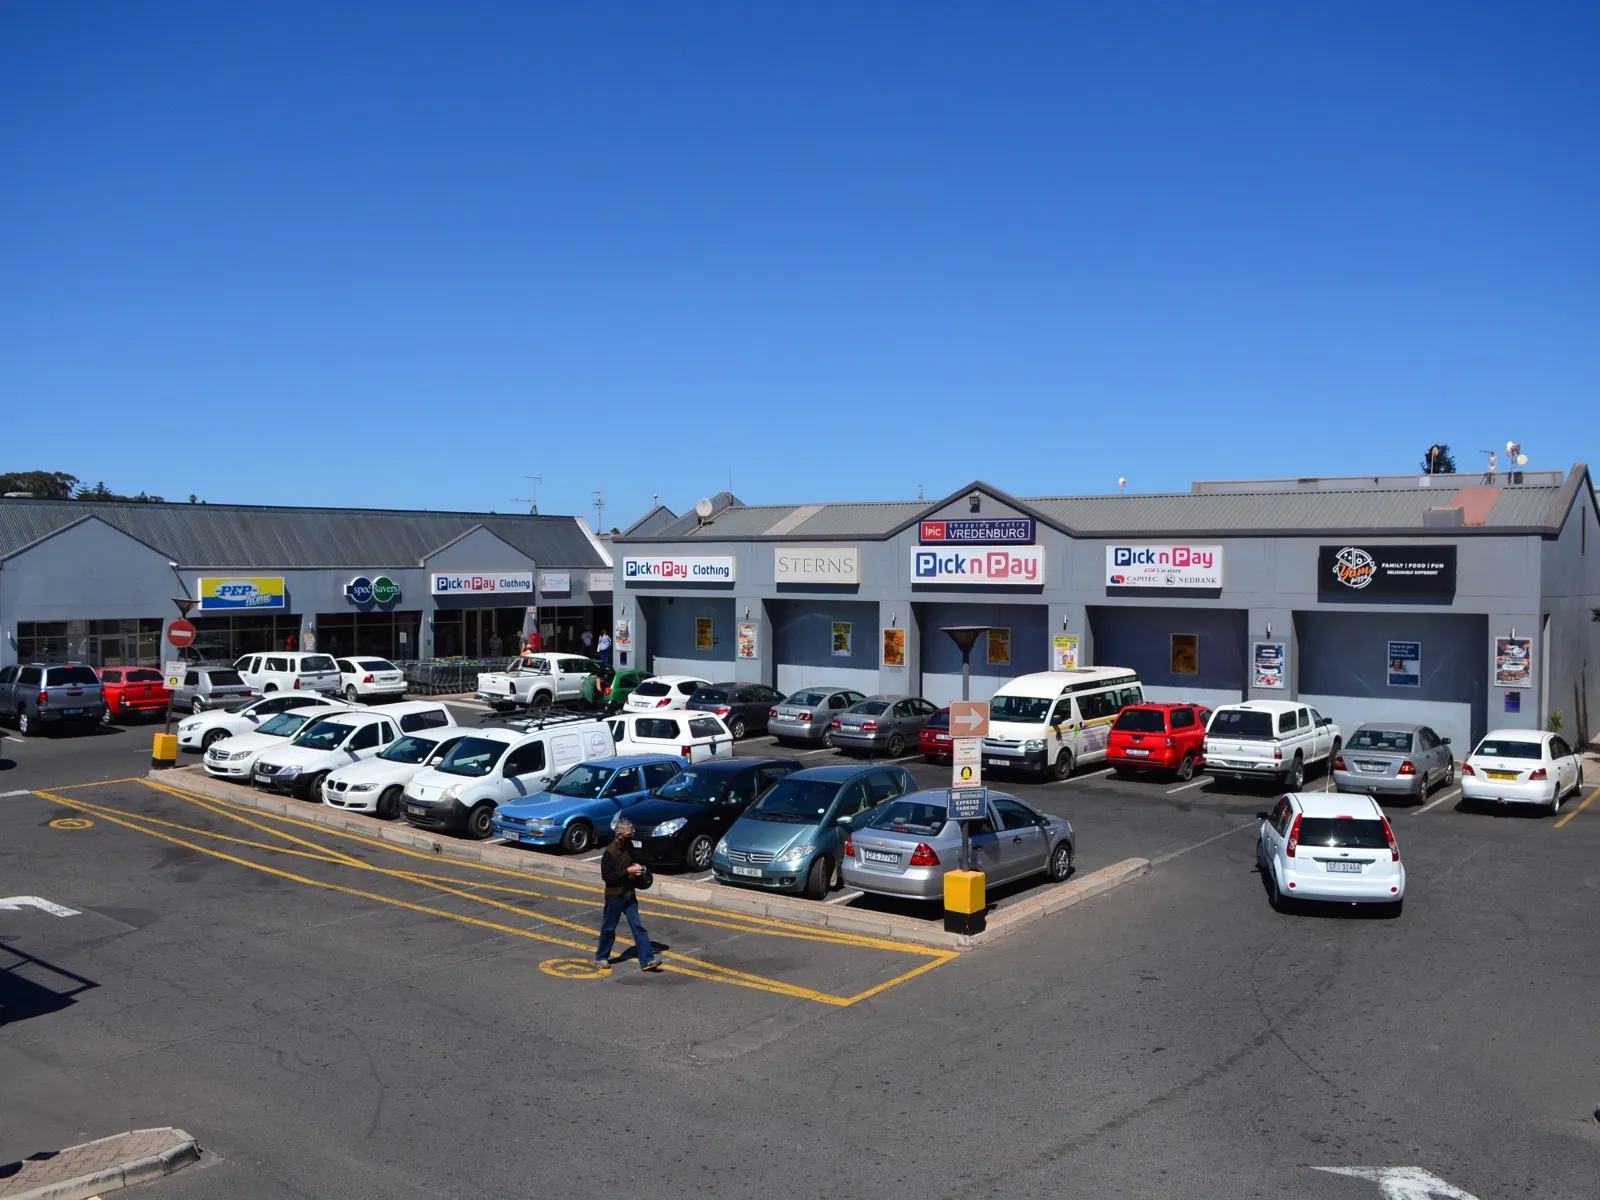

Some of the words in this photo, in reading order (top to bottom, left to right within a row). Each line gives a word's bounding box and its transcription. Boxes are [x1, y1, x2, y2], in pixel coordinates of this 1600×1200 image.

[950, 528, 1025, 538] VREDENBURG
[778, 556, 853, 573] STERNS
[916, 552, 966, 578] Pick
[970, 558, 982, 574] n
[986, 552, 1036, 580] Pay
[1114, 548, 1155, 566] Pick
[1158, 552, 1169, 564] n
[1172, 548, 1213, 568] Pay
[626, 560, 652, 576] Pick
[654, 564, 660, 574] n
[662, 560, 688, 578] Pay
[692, 564, 730, 578] Clothing
[219, 586, 253, 596] PEP
[436, 577, 462, 590] Pick
[464, 580, 470, 588] n
[472, 576, 496, 590] Pay
[500, 579, 530, 590] Clothing
